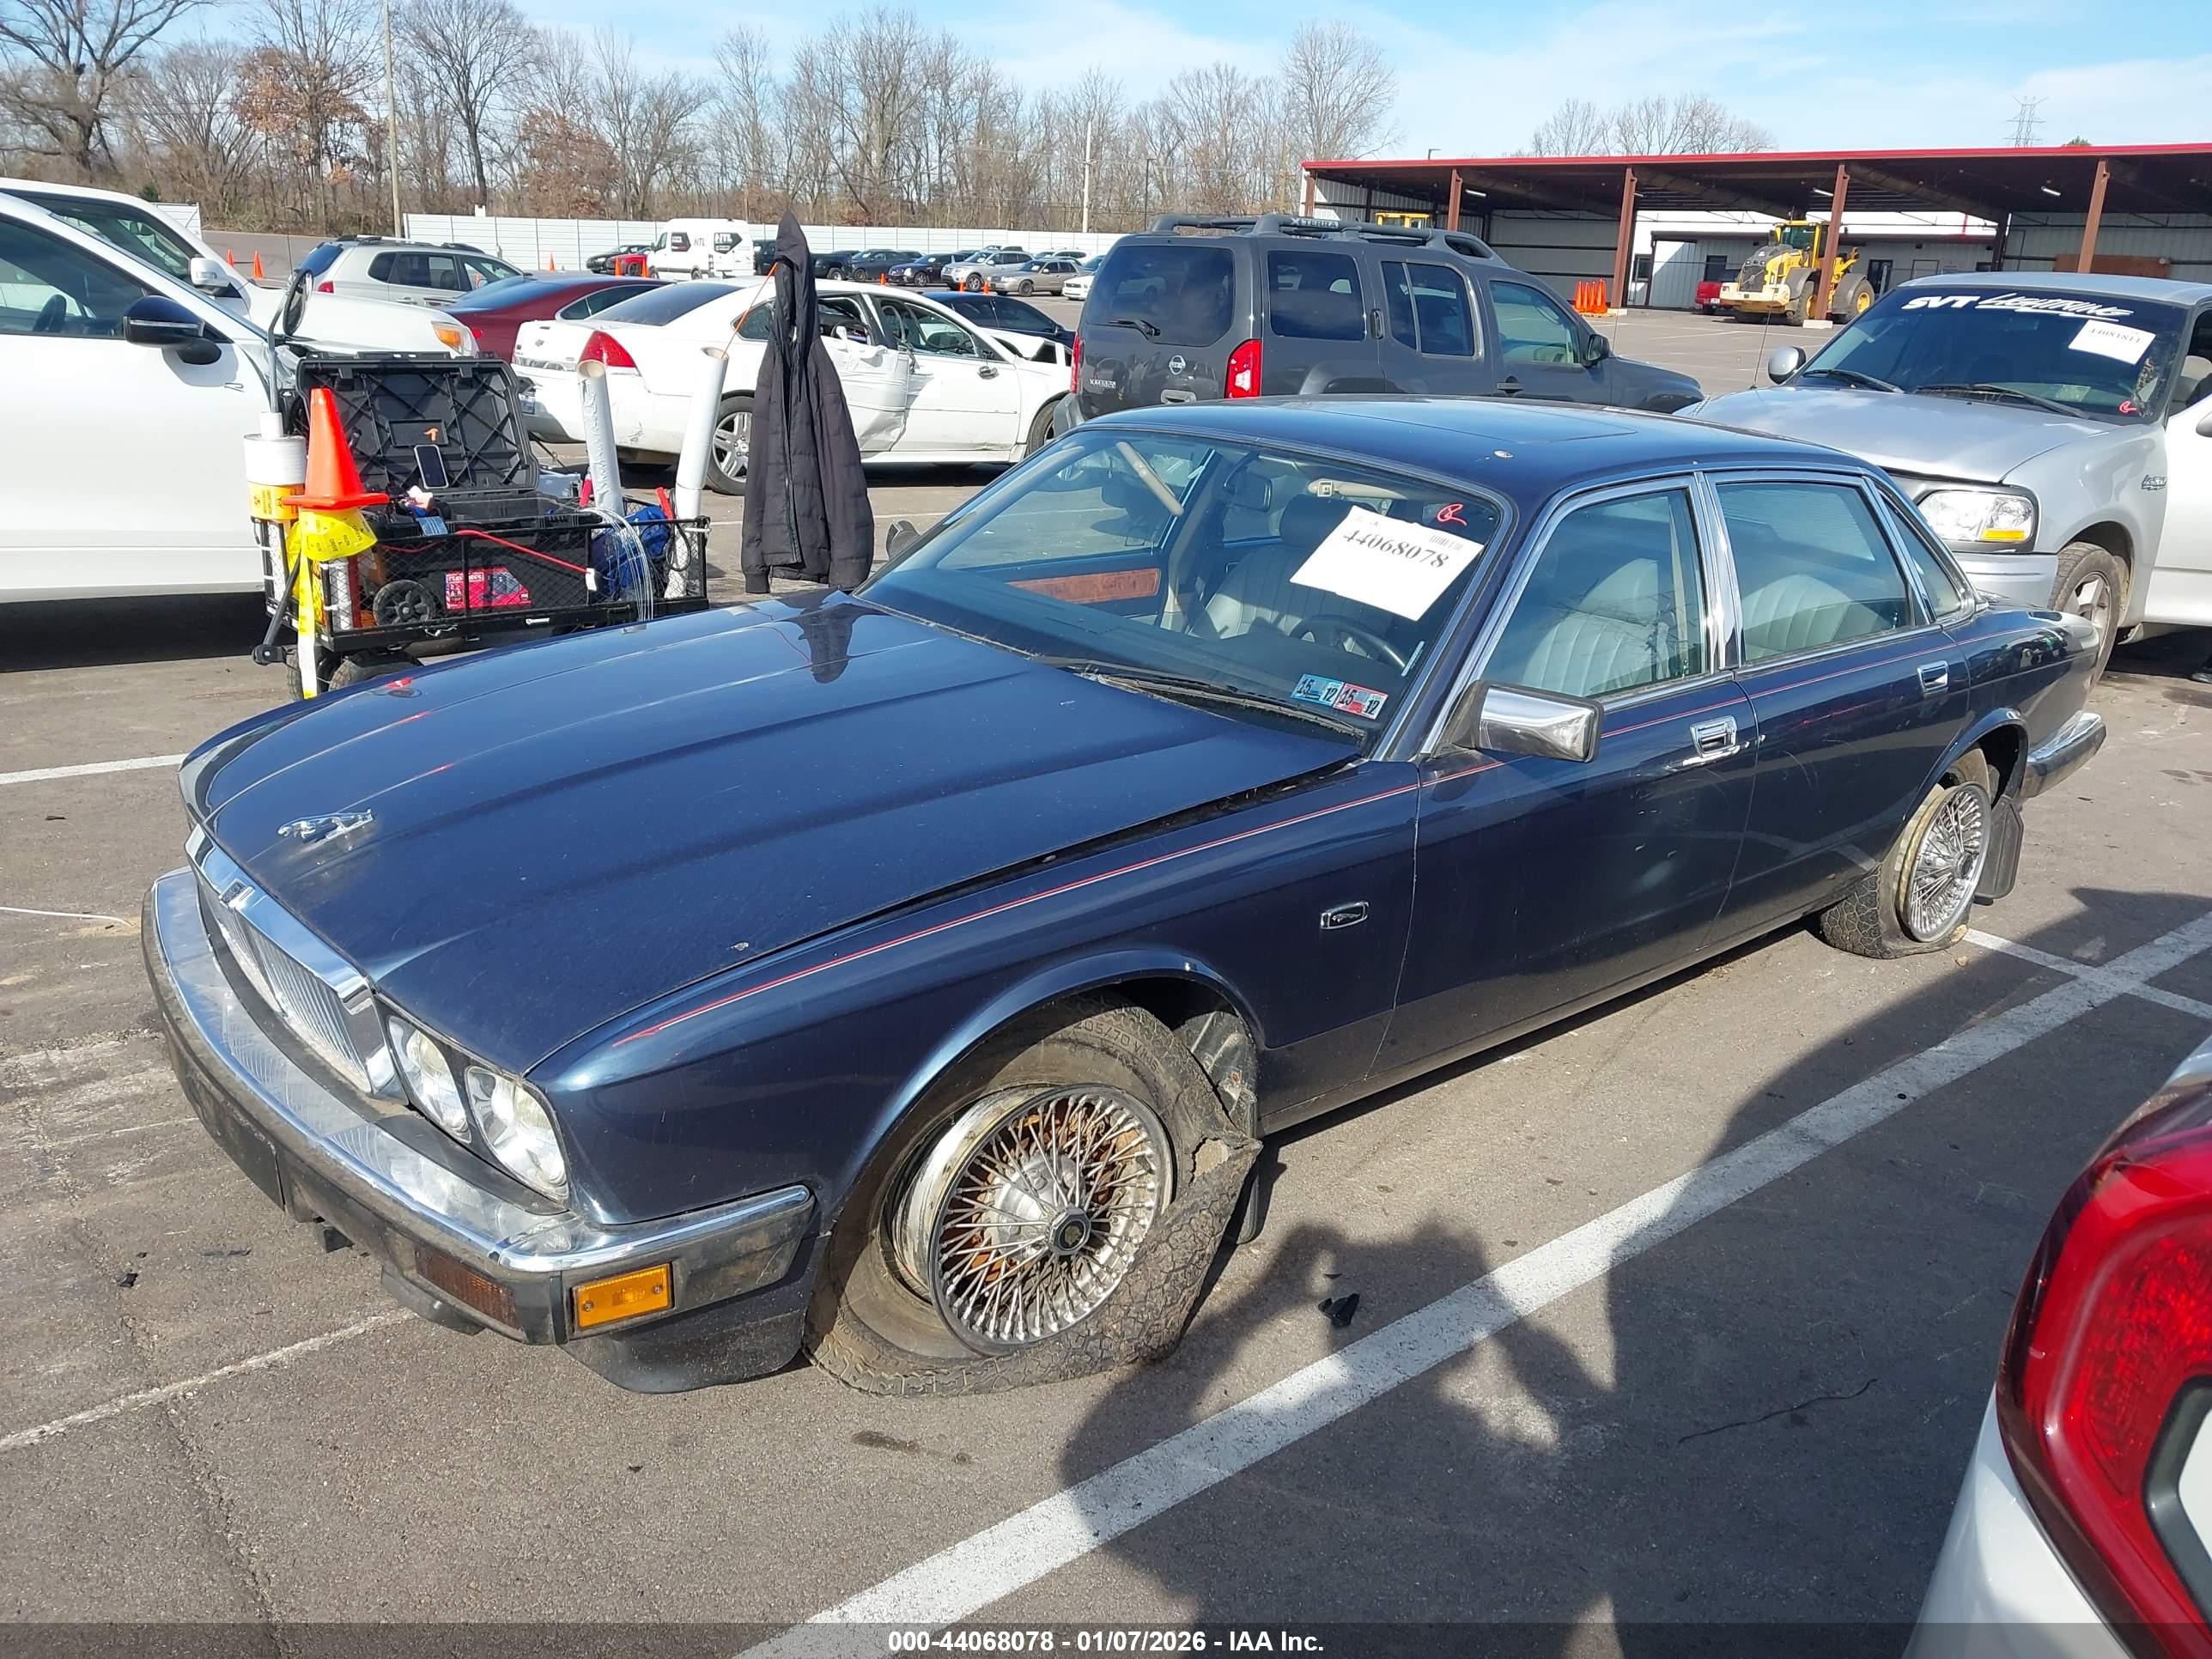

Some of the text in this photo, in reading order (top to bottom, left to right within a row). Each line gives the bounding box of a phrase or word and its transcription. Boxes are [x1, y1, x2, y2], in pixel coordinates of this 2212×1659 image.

[1291, 216, 1339, 229] XTERRA
[1901, 292, 2135, 318] SVT LIGHTNING
[1342, 529, 1449, 568] 44068078
[1323, 687, 1338, 702] 12
[1339, 688, 1381, 714] 15 12
